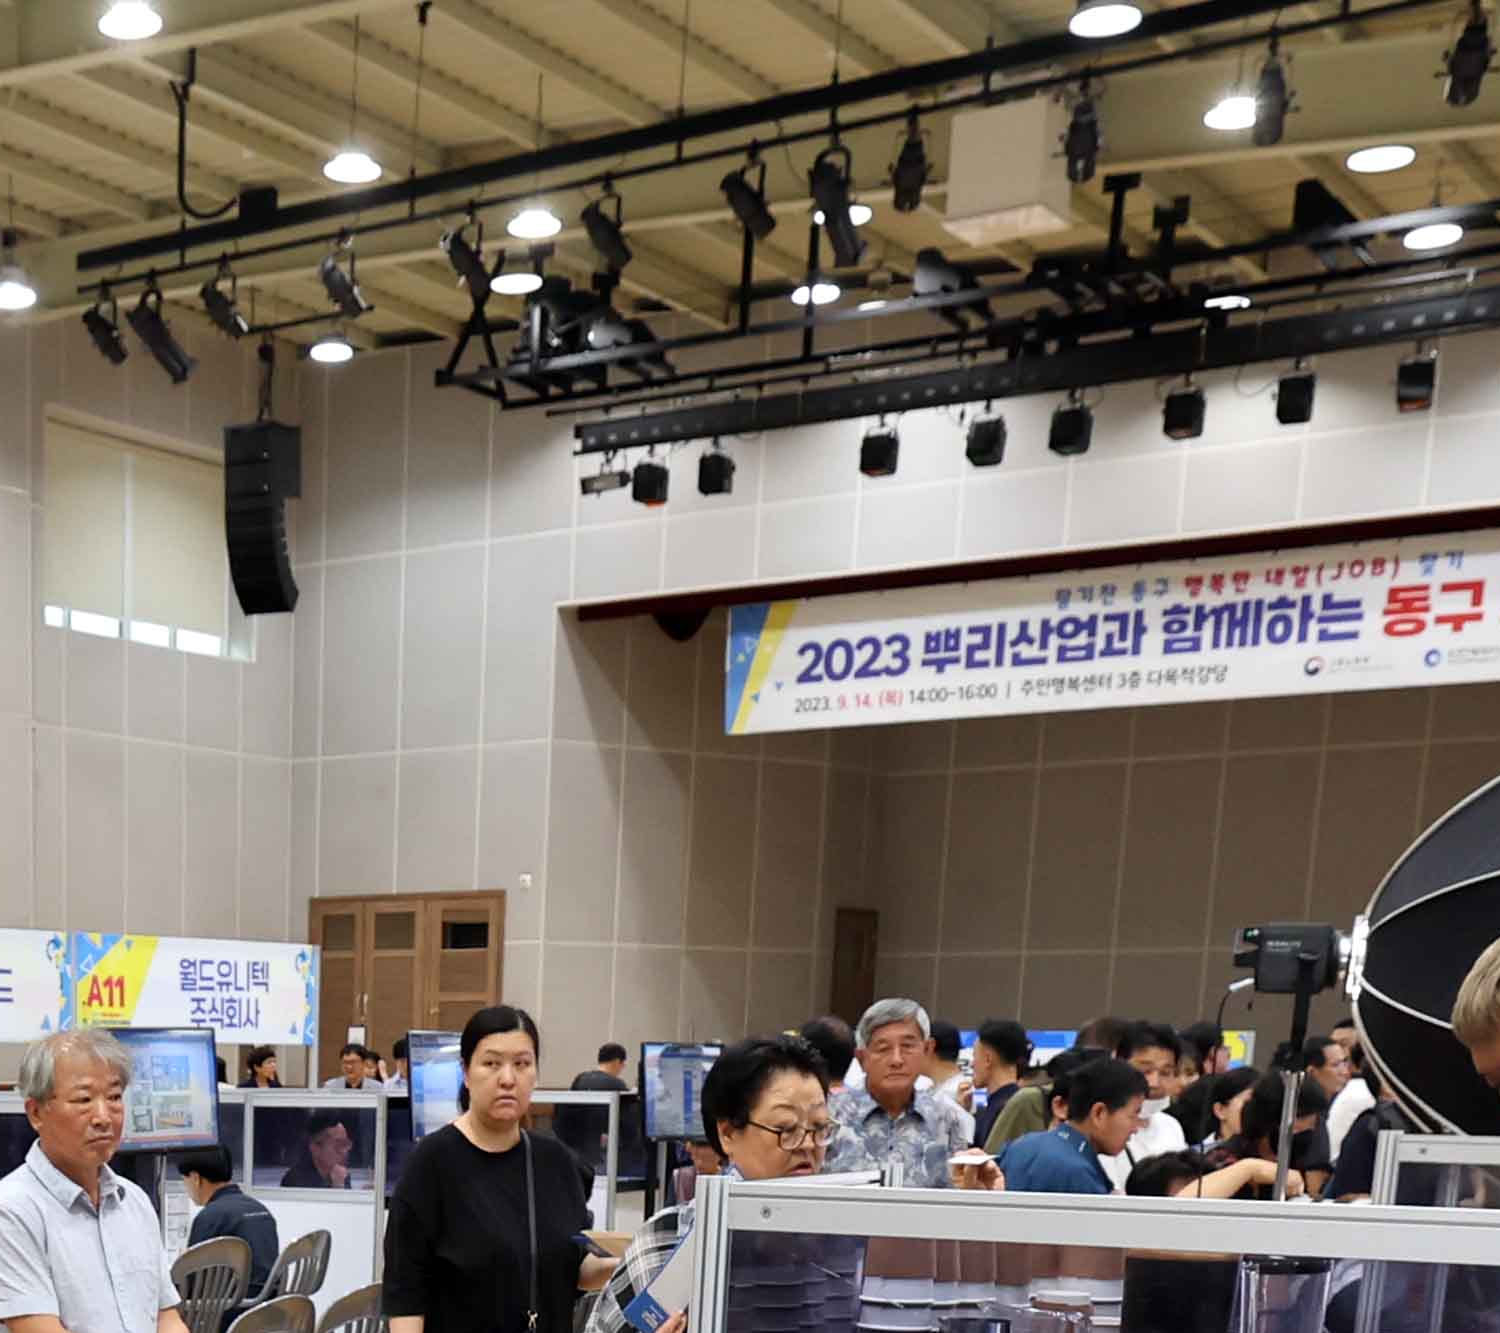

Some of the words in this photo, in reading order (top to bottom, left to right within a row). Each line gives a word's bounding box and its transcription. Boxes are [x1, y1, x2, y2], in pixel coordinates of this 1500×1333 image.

[1130, 577, 1171, 599] 동구
[1182, 567, 1252, 598] 행복한
[1263, 555, 1401, 589] 내일(JOB)
[795, 632, 911, 684] 2023
[920, 606, 1148, 675] 뿌리산업과
[1161, 592, 1365, 655] 함께하는
[1381, 579, 1486, 638] 동구
[87, 975, 127, 1009] A11
[178, 957, 271, 997] 월드유니텍
[189, 998, 260, 1031] 주식회사
